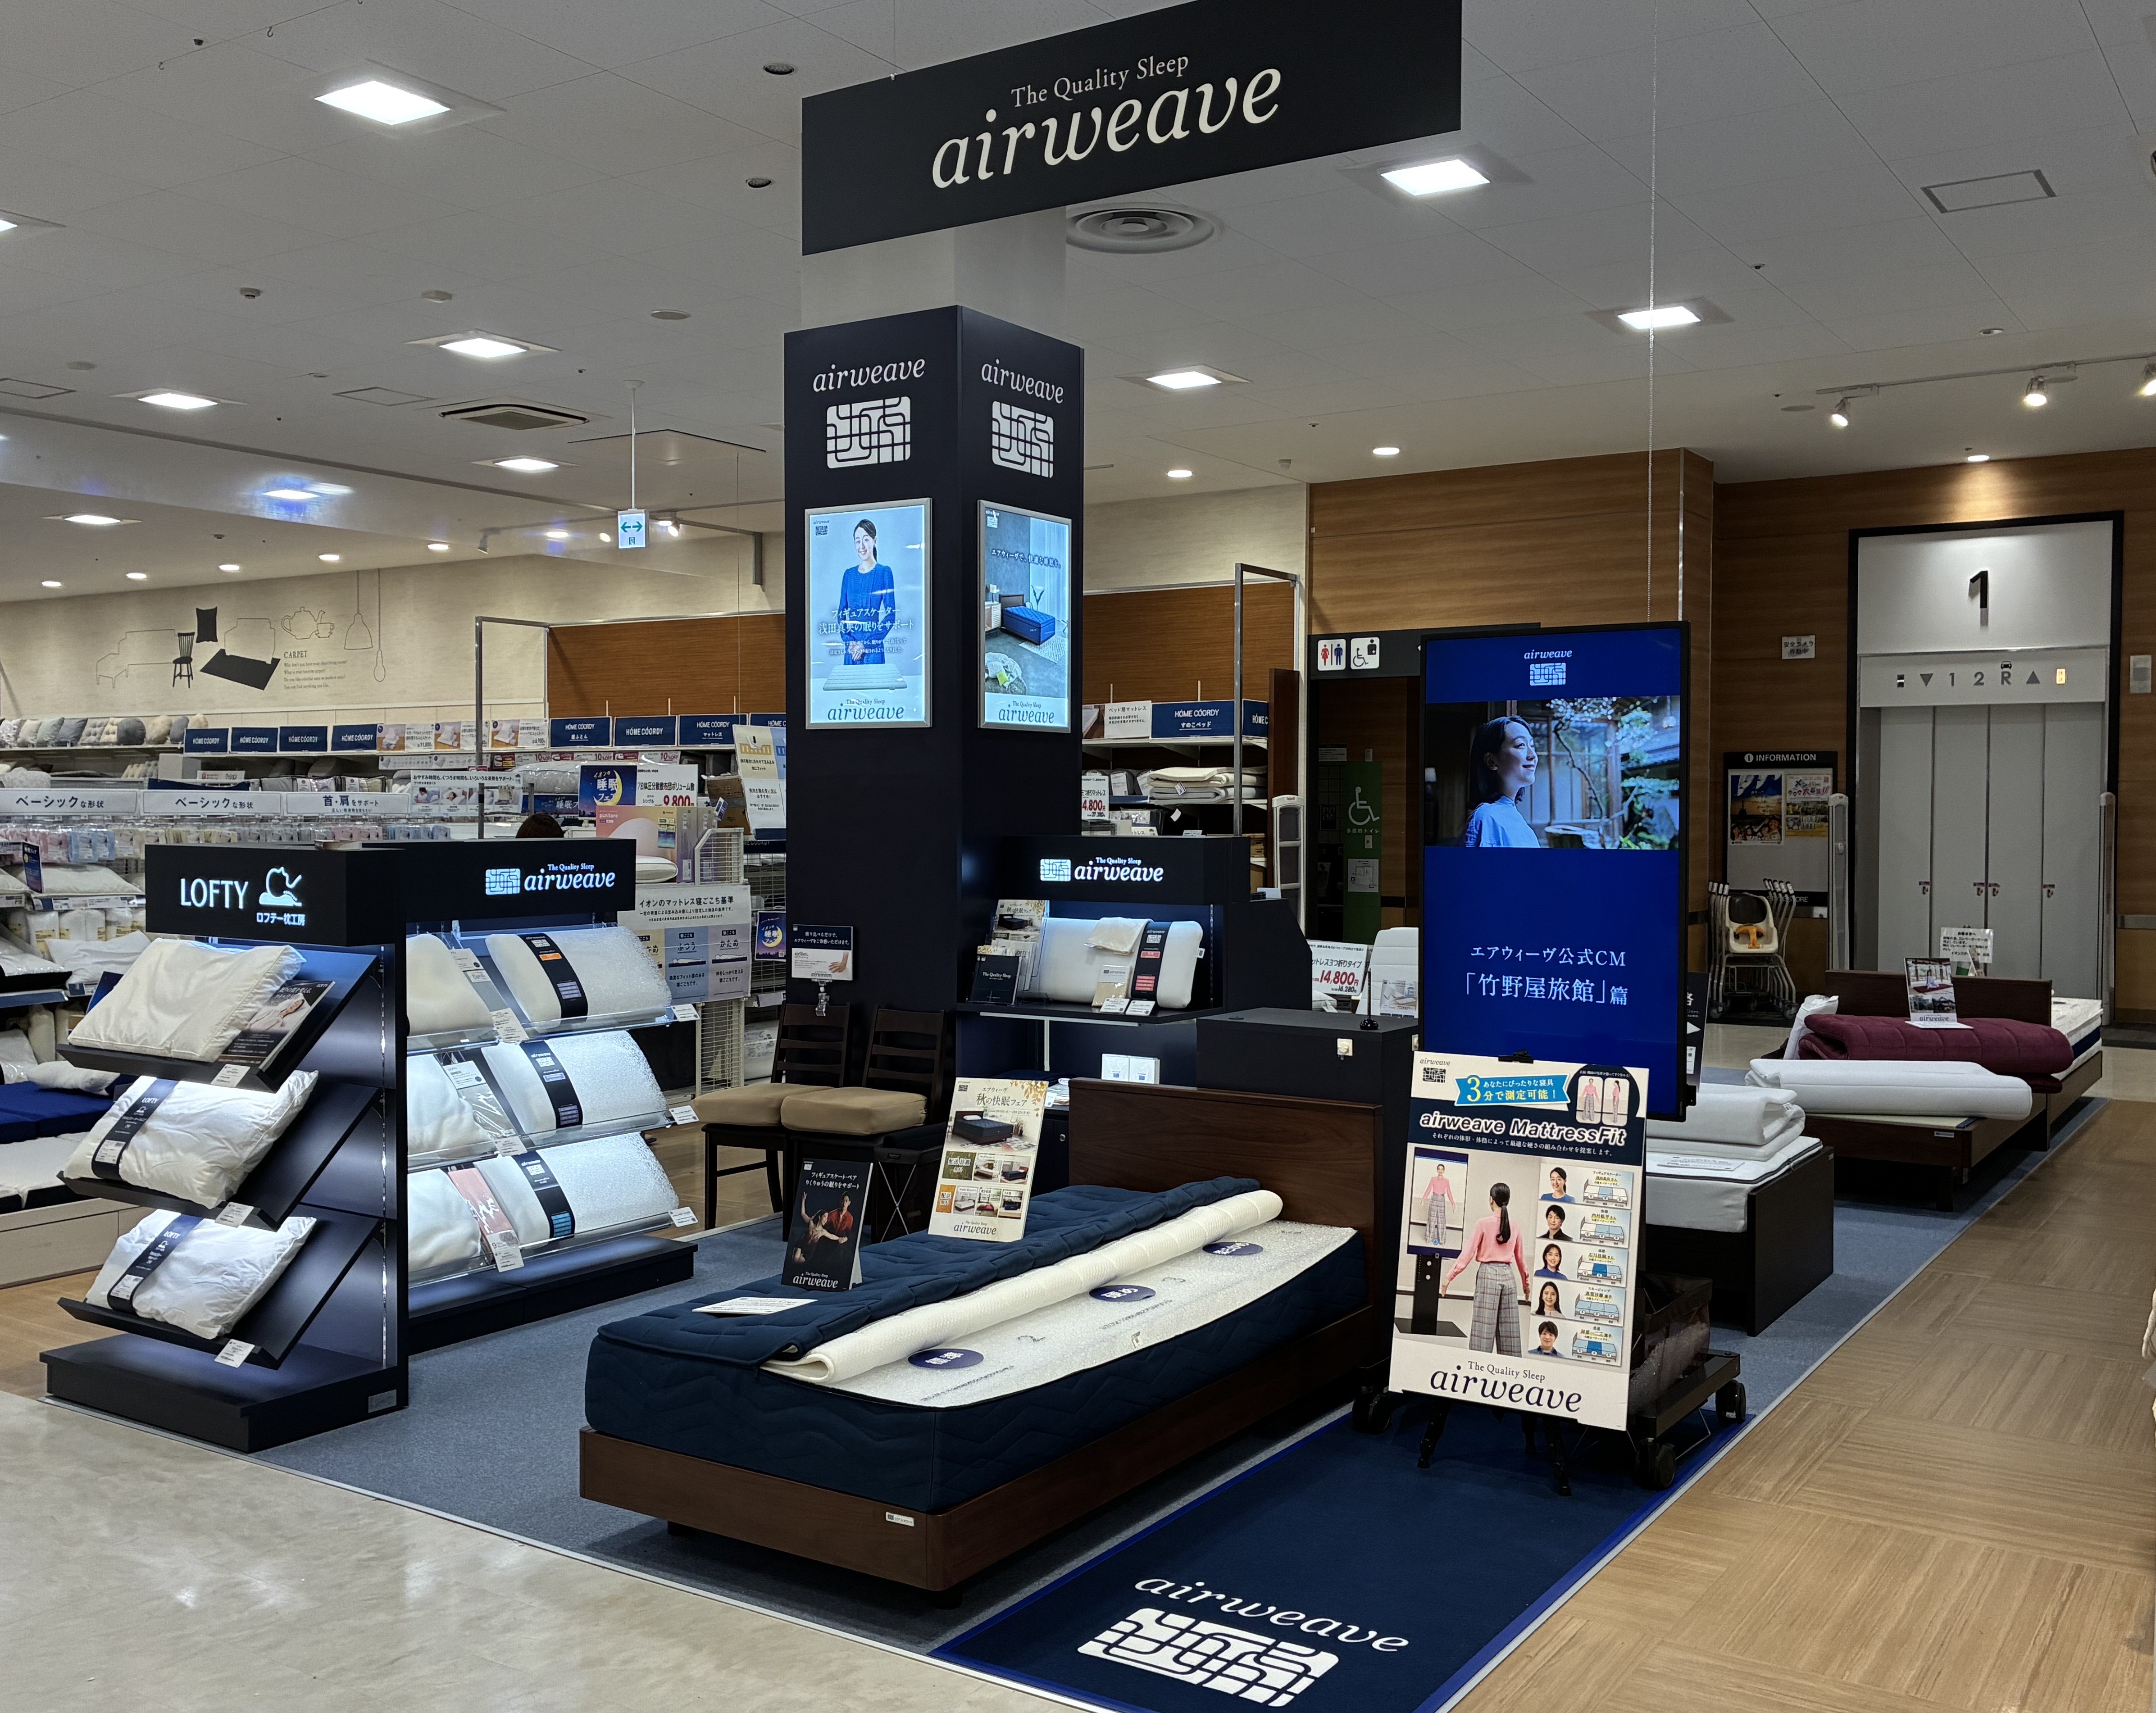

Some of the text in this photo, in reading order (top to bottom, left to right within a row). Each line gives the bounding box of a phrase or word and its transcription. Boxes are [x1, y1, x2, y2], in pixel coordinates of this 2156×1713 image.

[1012, 55, 1190, 108] The Quality Sleep
[932, 67, 1281, 188] airweave
[812, 358, 925, 392] airweave
[981, 359, 1064, 404] airweave
[1970, 570, 1988, 609] 1
[832, 606, 901, 619] フィギュアスケーター
[819, 619, 914, 635] 浅田真央の眠りをサポート
[284, 650, 308, 659] CARPET
[1523, 648, 1572, 660] airweave
[1949, 671, 2011, 686] 1 2 R
[828, 703, 904, 720] airweave
[998, 704, 1055, 724] airweave
[1180, 721, 1212, 729] すのこベッド
[1756, 754, 1816, 762] INFORMATION
[593, 770, 611, 779] イオンの
[596, 778, 618, 791] 睡眠
[16, 795, 104, 808] ベーシックな形状
[175, 797, 254, 809] ベーシックな形状
[323, 795, 379, 807] 首・肩をサポート
[556, 800, 579, 809] 睡眠フ
[547, 863, 594, 872] The Quality Sleep
[1106, 857, 1127, 865] Quality
[1128, 857, 1142, 866] Sleep
[1074, 860, 1164, 882] airweave
[524, 868, 616, 891] airweave
[180, 878, 249, 909] LOFTY
[639, 895, 734, 909] イオンのマットレス寝ごこち基準
[256, 912, 306, 927] ロフテー枕工房
[677, 941, 696, 951] ふつう
[719, 939, 739, 948] かため
[1470, 945, 1626, 967] エアウィーヴ公式CM
[1319, 969, 1359, 986] 14,800円
[1465, 972, 1628, 1006] 「竹野屋旅館」篇
[1420, 1058, 1451, 1067] airweave
[1467, 1077, 1481, 1102] 3
[1483, 1079, 1554, 1089] あなたにぴったりな寝具
[976, 1093, 1028, 1107] 秋の快眠フェア
[1419, 1112, 1628, 1147] airweave MattressFit
[953, 1222, 997, 1235] airweave
[793, 1273, 838, 1288] airweave
[1467, 1361, 1546, 1383] The Quality Sleep
[1430, 1365, 1582, 1413] airweave
[1134, 1578, 1409, 1652] airweave
